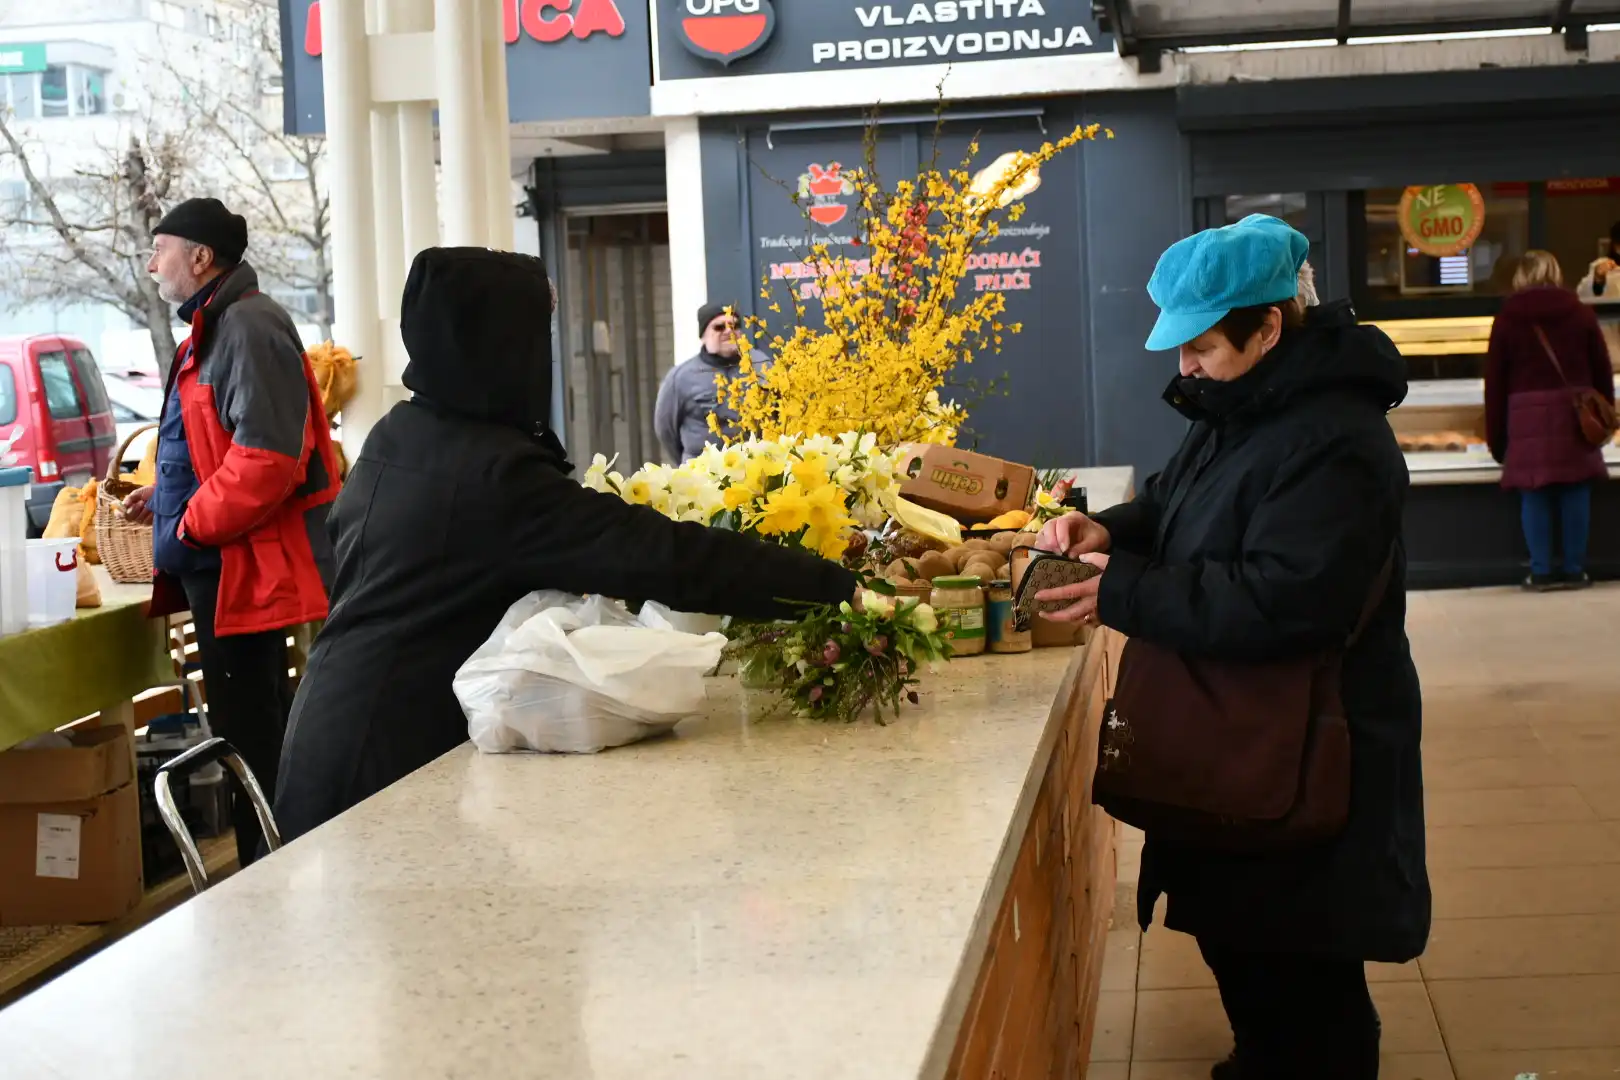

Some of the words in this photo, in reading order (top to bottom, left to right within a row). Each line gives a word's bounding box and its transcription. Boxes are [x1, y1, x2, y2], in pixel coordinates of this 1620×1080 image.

[855, 0, 1046, 28] VLASTITA
[812, 26, 1093, 64] PROIZVODNJA
[1415, 184, 1447, 210] NE
[989, 222, 1051, 242] roizvodnja
[1420, 215, 1464, 238] GMO
